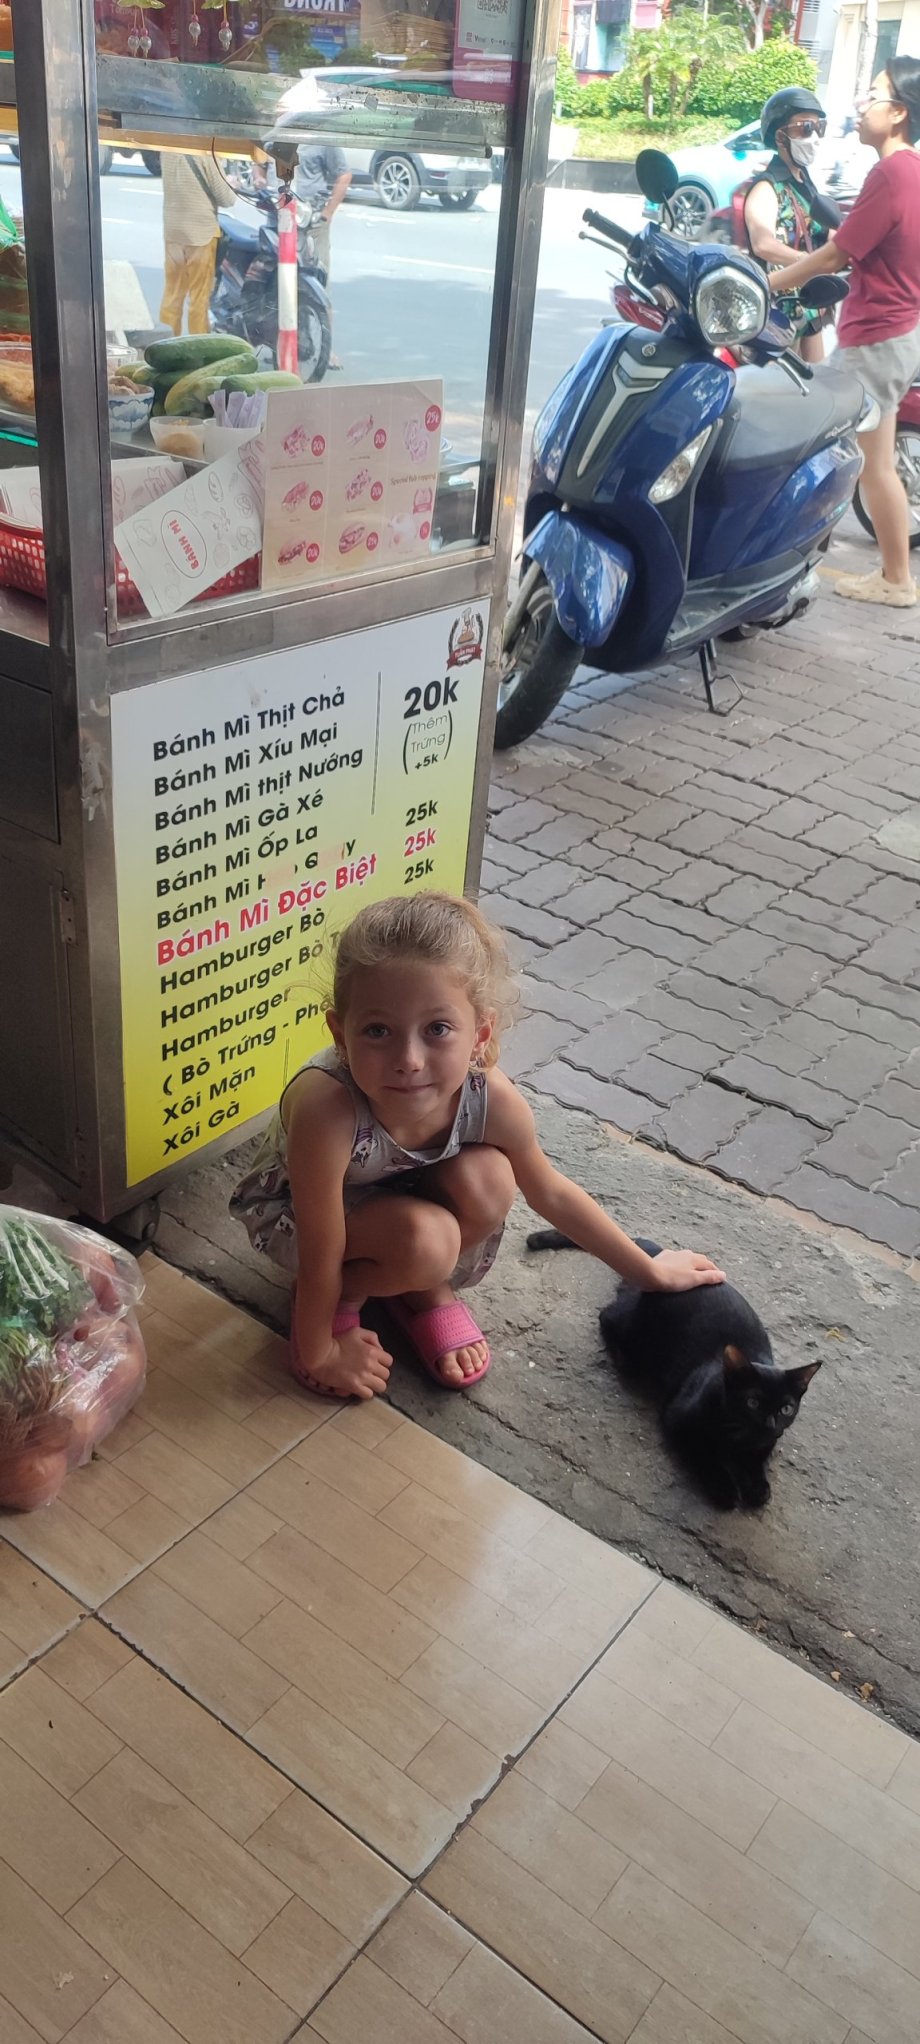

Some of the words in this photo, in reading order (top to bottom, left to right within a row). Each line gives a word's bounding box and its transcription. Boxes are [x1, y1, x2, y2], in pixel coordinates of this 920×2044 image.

[153, 728, 216, 762] Bánh
[224, 714, 250, 740] Mì
[257, 702, 296, 730] Thịt
[302, 686, 345, 716] Chả
[403, 676, 460, 720] 20k
[154, 763, 216, 797] Bánh
[225, 749, 250, 775] Mì
[258, 738, 293, 764] Xíu
[300, 722, 338, 750] Mại
[155, 797, 217, 831] Bánh
[225, 782, 250, 808] Mì
[258, 770, 292, 796] thịt
[299, 749, 363, 783] Nướng
[155, 830, 217, 865] Bánh
[225, 815, 250, 841] Mì
[257, 802, 289, 828] Gà
[296, 788, 324, 815] Xé
[403, 827, 437, 857] 25k
[405, 800, 438, 827] 25k
[156, 863, 217, 898] Bánh
[225, 846, 250, 873] Mì
[257, 831, 289, 858] Ốp
[296, 825, 318, 845] La
[403, 858, 435, 885] 25k
[157, 895, 217, 930] Bánh
[225, 878, 250, 904] Mì
[157, 918, 230, 966] Bánh
[239, 898, 269, 932] Mì
[277, 879, 328, 916] Đặc
[335, 853, 377, 891] Biệt
[160, 924, 294, 995] Hamburger
[300, 907, 325, 933] Bò
[160, 956, 293, 1028] Hamburger
[162, 986, 291, 1062] Hamburger
[181, 1057, 210, 1085] Bò
[218, 1024, 276, 1065] Trứng
[162, 1091, 201, 1126] Xôi
[209, 1065, 256, 1101] Mặn
[162, 1122, 200, 1156] Xôi
[208, 1101, 240, 1129] Gà
